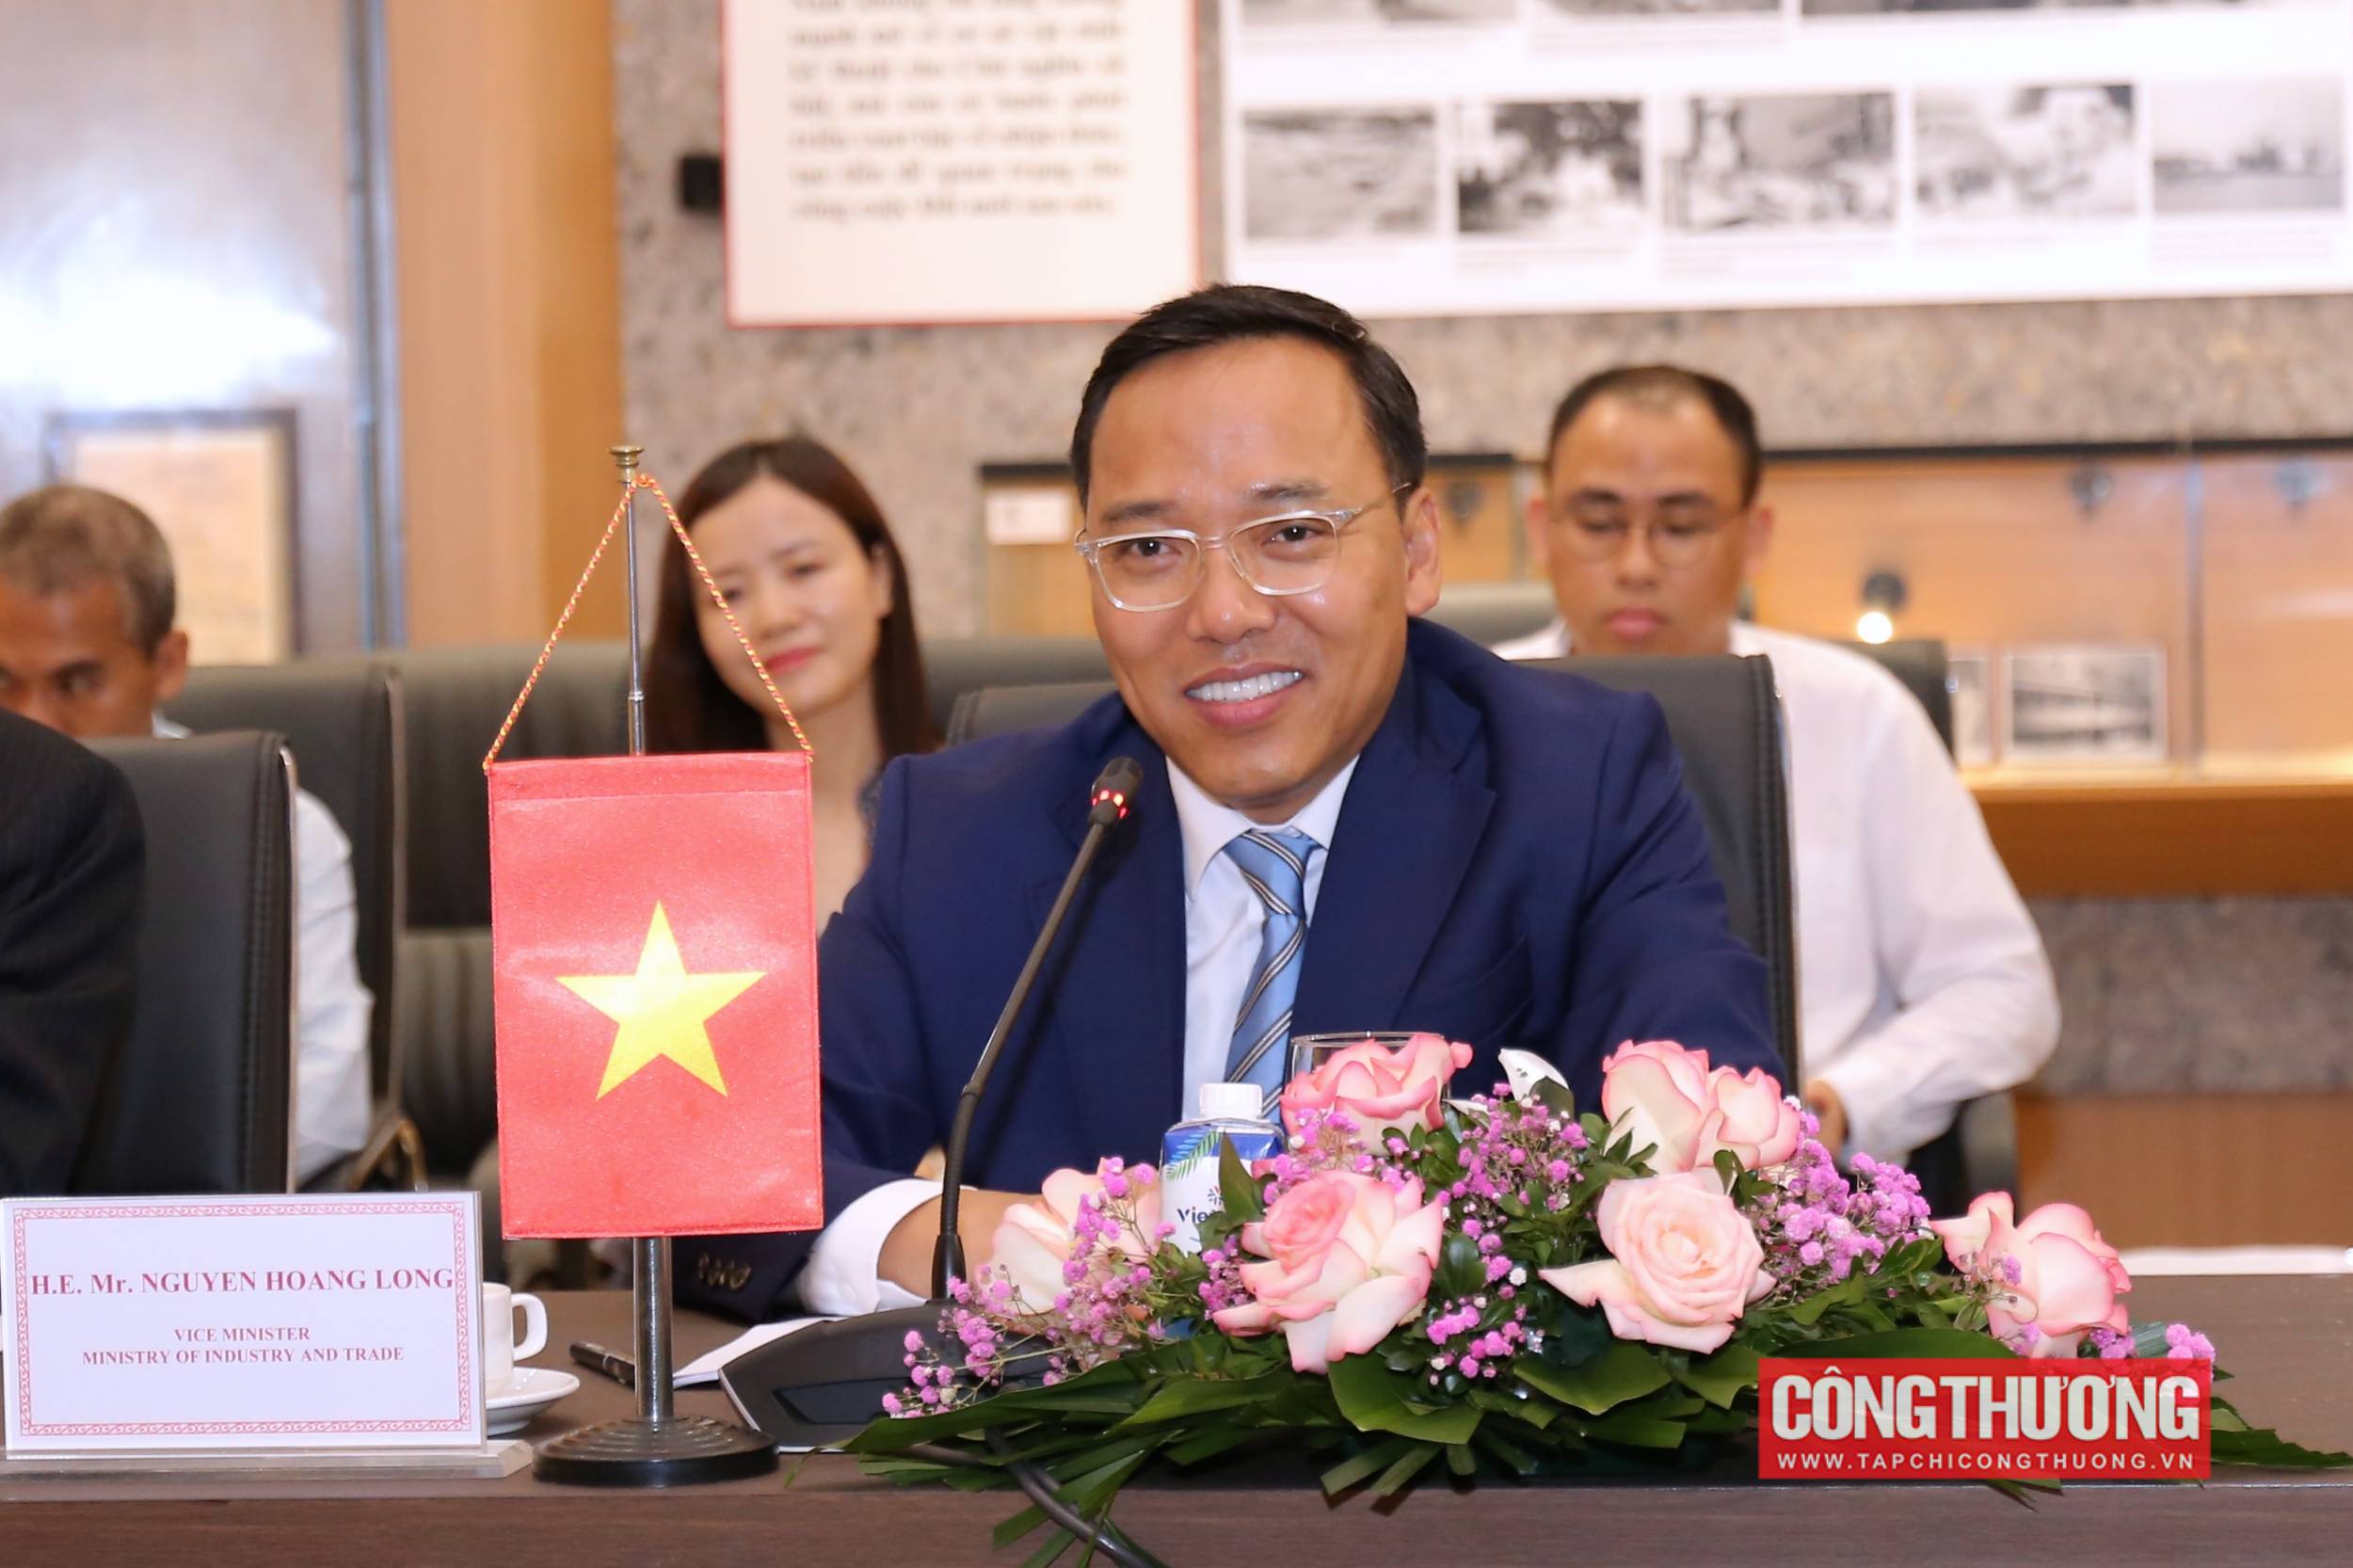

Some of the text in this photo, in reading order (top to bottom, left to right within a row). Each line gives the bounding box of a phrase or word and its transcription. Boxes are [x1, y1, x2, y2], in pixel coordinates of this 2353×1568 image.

[1176, 1207, 1211, 1224] Vie
[32, 1269, 454, 1295] H.E. Mr. NGUYEN HOANG LONG
[174, 1327, 310, 1342] VICE MINISTER
[83, 1347, 405, 1366] MINISTRY OF INDUSTRY AND TRADE
